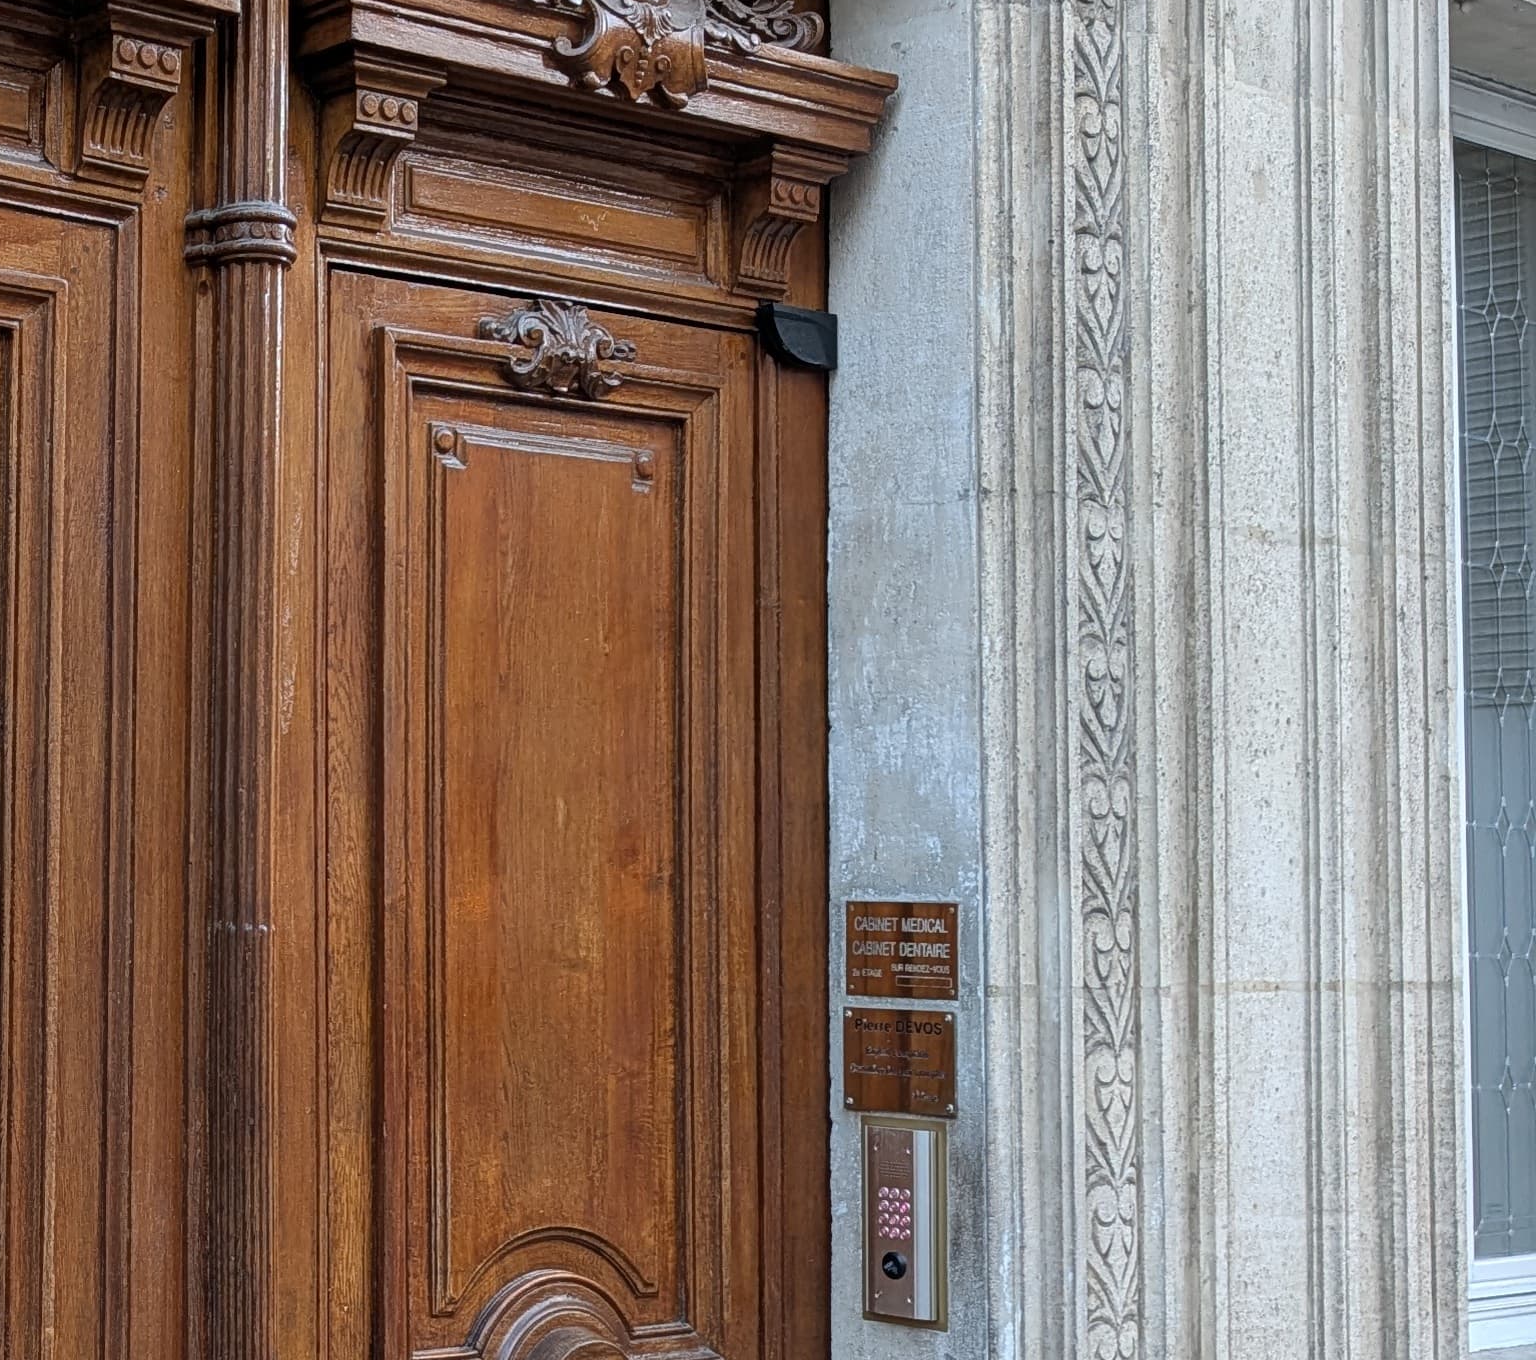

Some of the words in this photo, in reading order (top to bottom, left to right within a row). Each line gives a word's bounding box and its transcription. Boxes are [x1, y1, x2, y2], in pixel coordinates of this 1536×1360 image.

[854, 915, 898, 932] CABINET
[901, 917, 949, 934] MEDICAL
[852, 940, 897, 957] CABINET
[899, 942, 951, 959] DENTAIRE
[854, 1018, 892, 1033] Pierre
[895, 1020, 943, 1036] DEVOS
